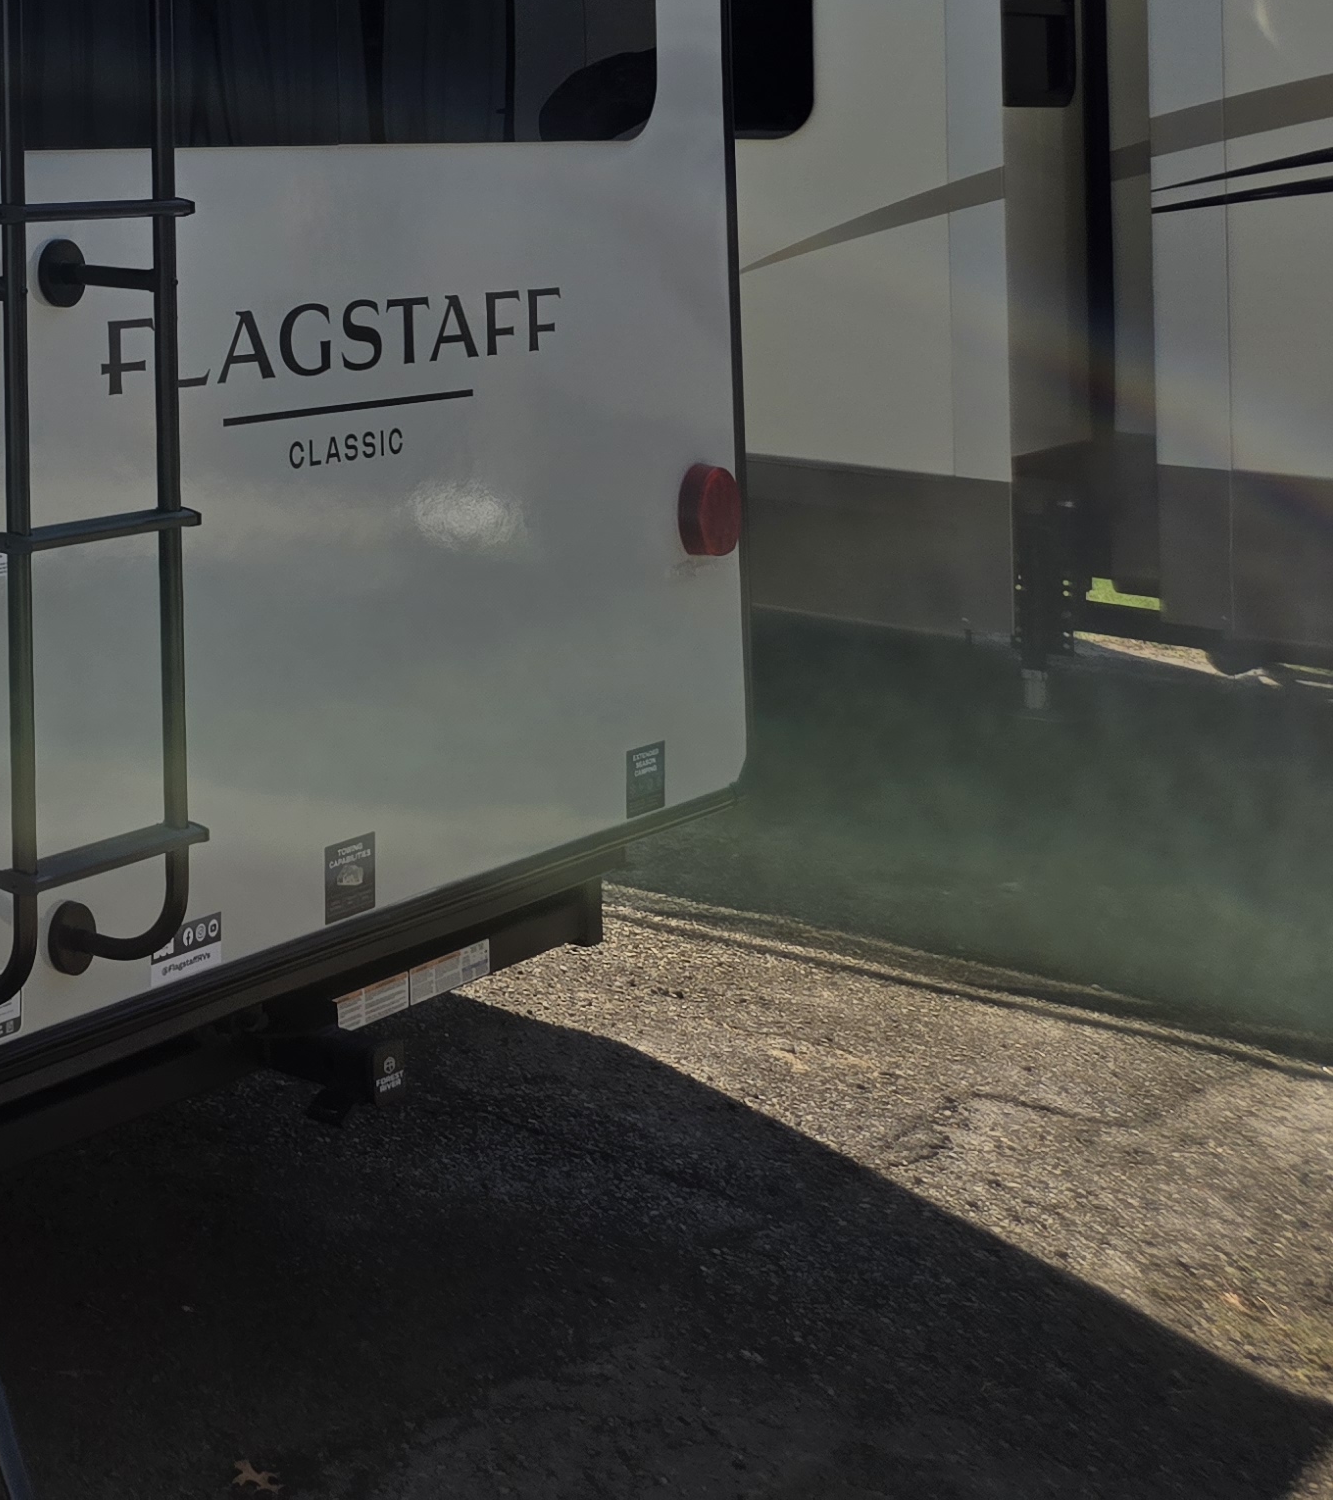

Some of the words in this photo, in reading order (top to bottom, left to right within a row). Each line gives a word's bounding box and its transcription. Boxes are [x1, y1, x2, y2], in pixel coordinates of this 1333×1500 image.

[288, 427, 406, 470] CLASSIC
[328, 848, 372, 870] CAPABILITIES
[337, 842, 364, 857] TOWING
[161, 952, 212, 976] @FlagstaffRVs
[375, 1069, 405, 1088] FOREST
[379, 1078, 402, 1093] RIVER
